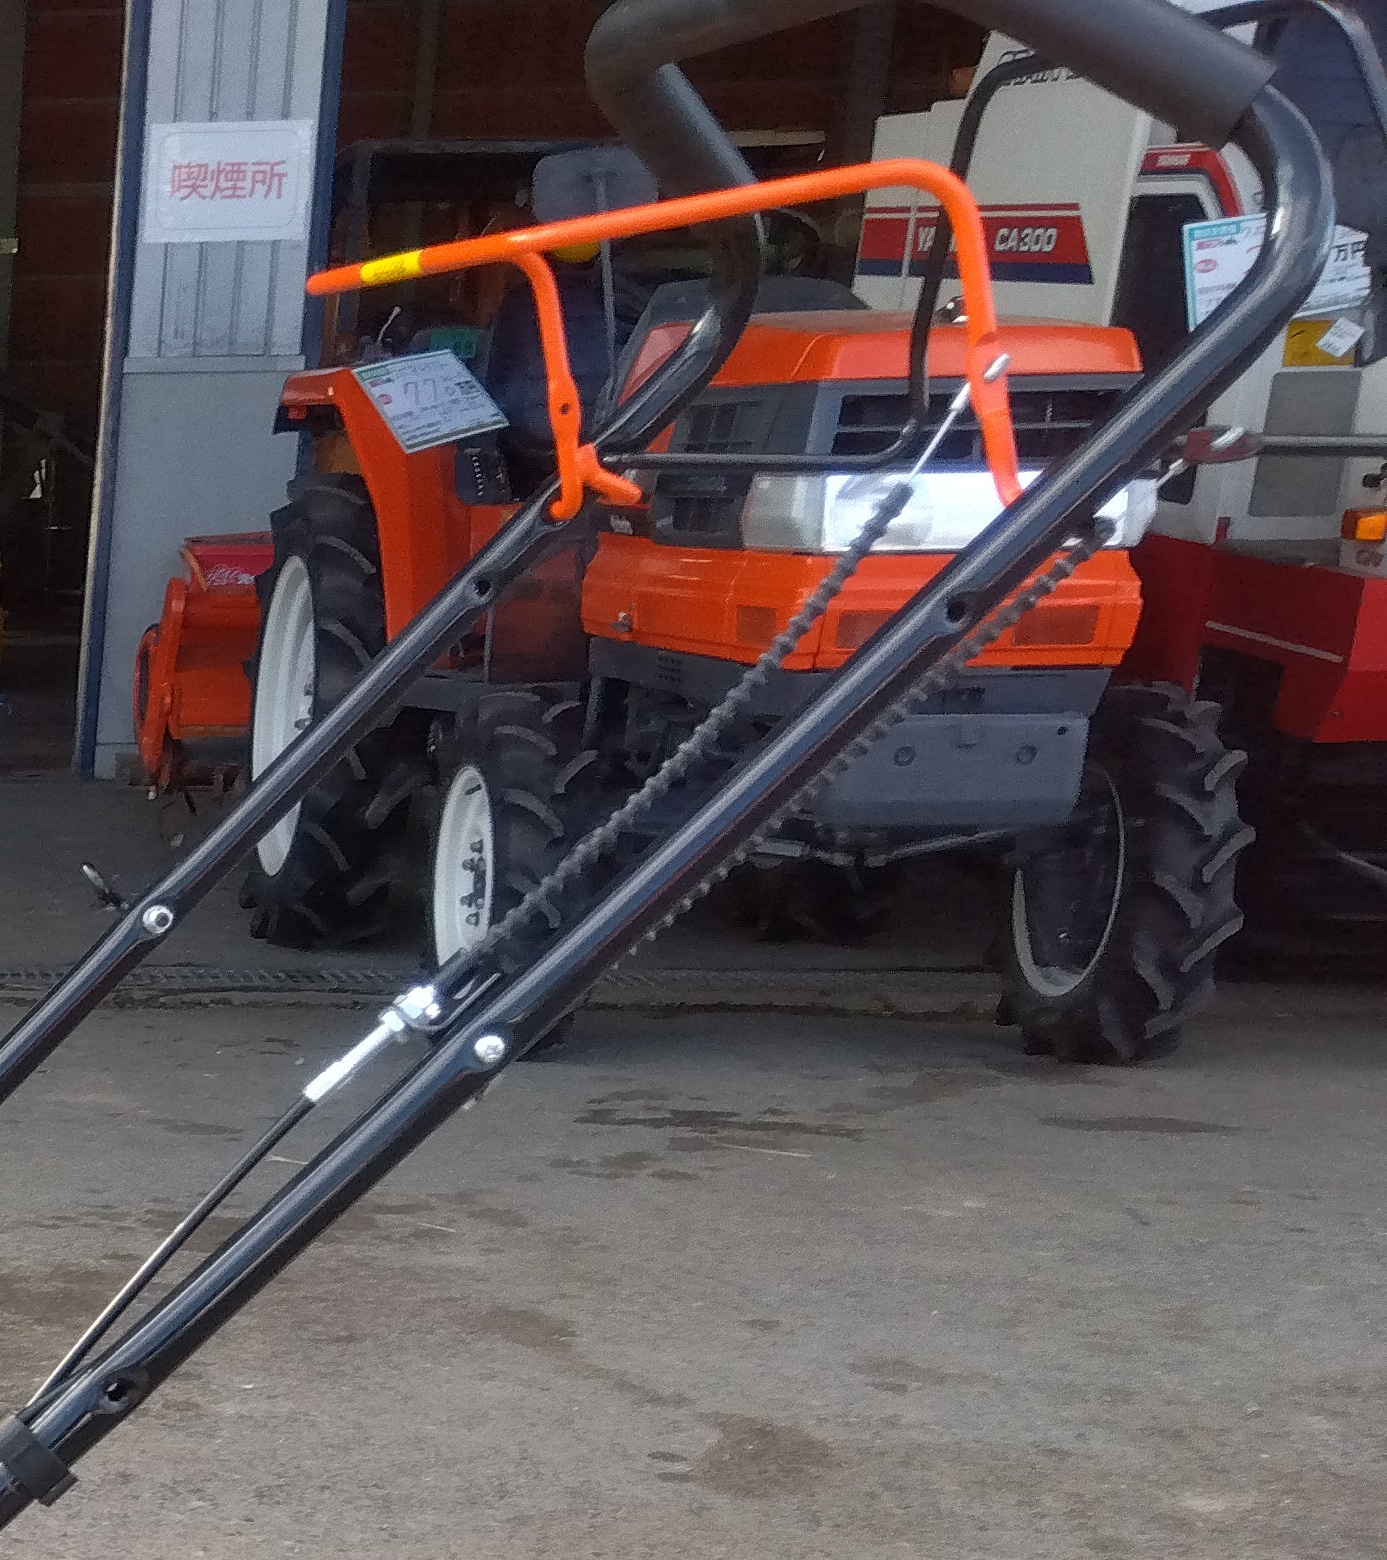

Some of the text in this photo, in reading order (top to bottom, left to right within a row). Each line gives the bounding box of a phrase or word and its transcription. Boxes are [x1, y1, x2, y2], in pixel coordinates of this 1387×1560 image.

[170, 160, 288, 201] 喫煙所
[994, 211, 1058, 252] CA300
